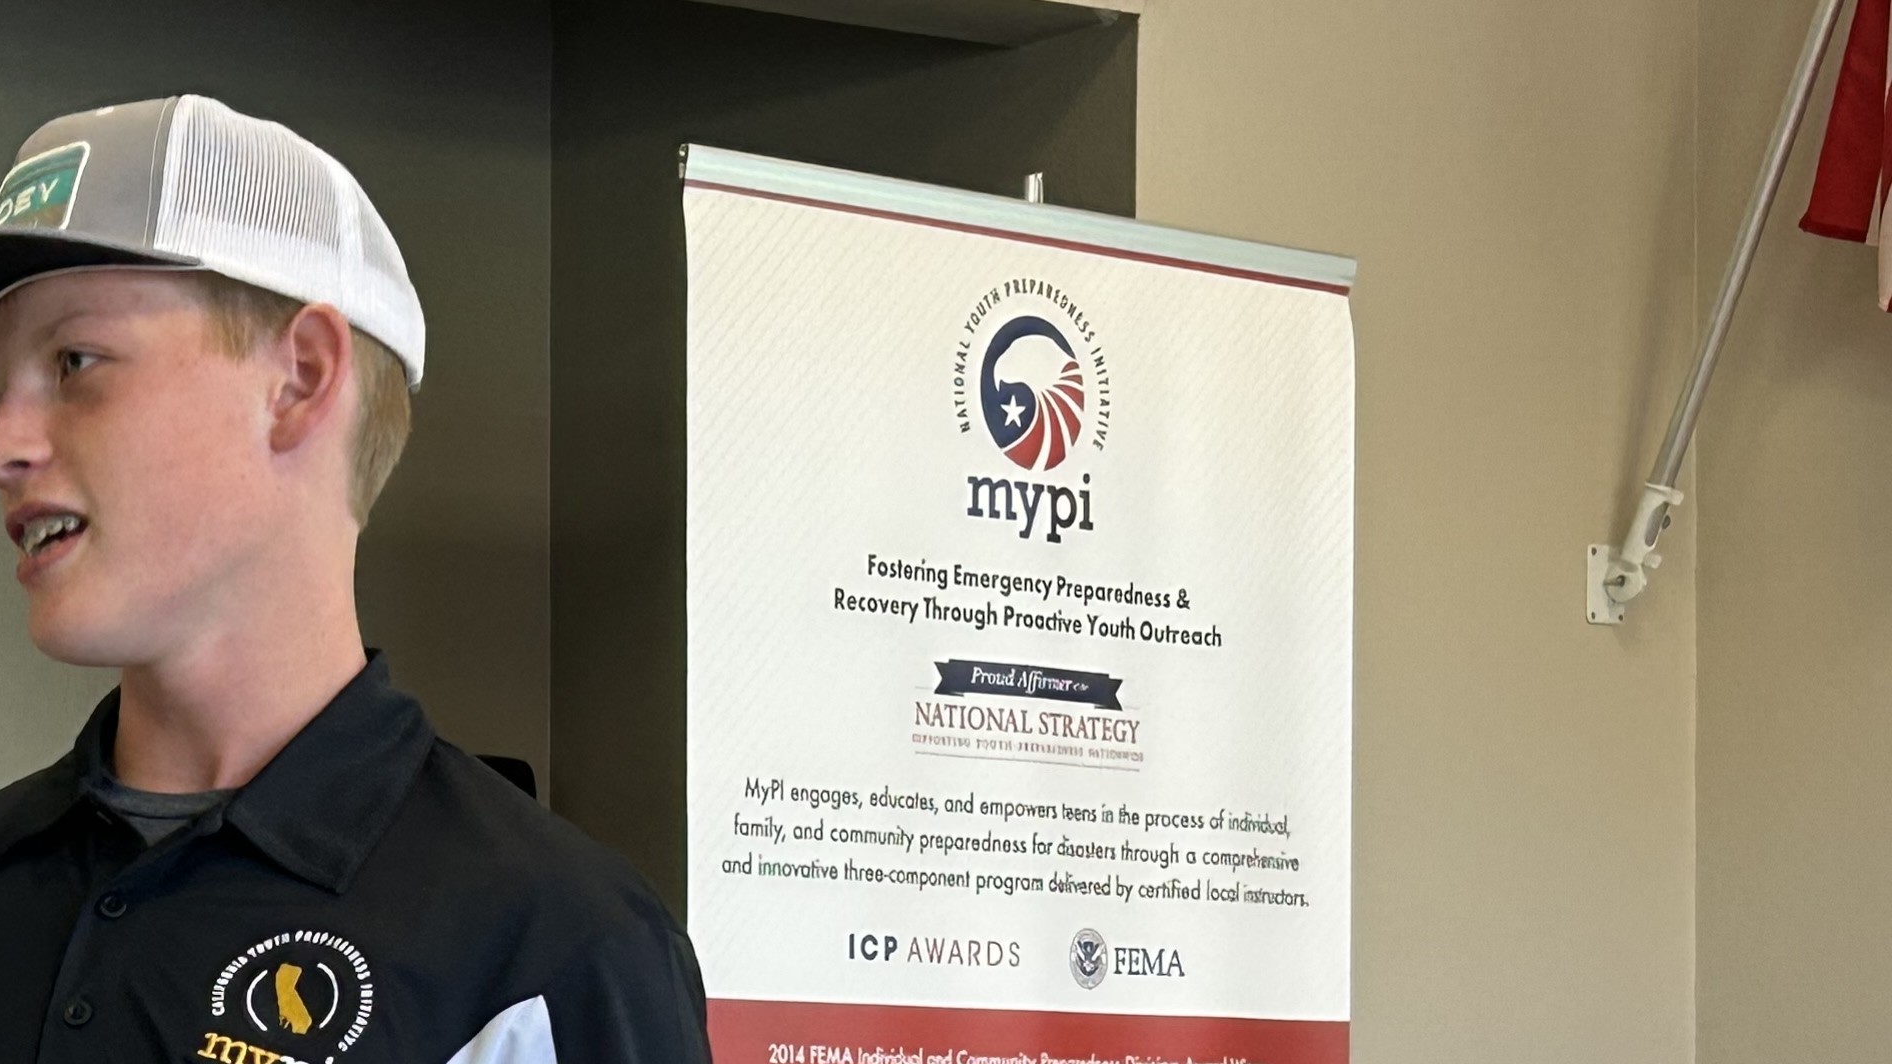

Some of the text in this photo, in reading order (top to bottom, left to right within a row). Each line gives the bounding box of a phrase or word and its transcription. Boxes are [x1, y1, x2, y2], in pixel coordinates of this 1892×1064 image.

[953, 278, 1111, 452] NATIONAL YOUTH PREPAREDNESS INITIATIVE
[966, 472, 1094, 543] mypi
[867, 553, 1190, 610] Fostering Emergency Preparedness &
[834, 587, 1222, 647] Recovery Through Proactive Youth Outreach
[970, 665, 1016, 686] Proud
[914, 701, 1140, 744] NATIONAL STRATEGY
[744, 776, 784, 806] MyPI
[790, 786, 863, 810] engages,
[869, 784, 939, 815] educates,
[943, 791, 974, 814] and
[979, 800, 1058, 822] empowers
[1061, 802, 1097, 823] teens
[1118, 803, 1140, 826] the
[1144, 812, 1205, 832] process
[1208, 807, 1224, 830] of
[733, 811, 1197, 869] family, and community preparedness for through a
[721, 851, 752, 875] and
[758, 854, 838, 880] innovative
[843, 858, 970, 891] three-component
[975, 874, 1043, 895] program
[1115, 874, 1133, 903] by
[1206, 878, 1239, 902] local
[848, 932, 1020, 967] ICP AWARDS
[1113, 946, 1185, 977] FEMA
[767, 1042, 805, 1064] 2014
[809, 1044, 854, 1064] FEMA
